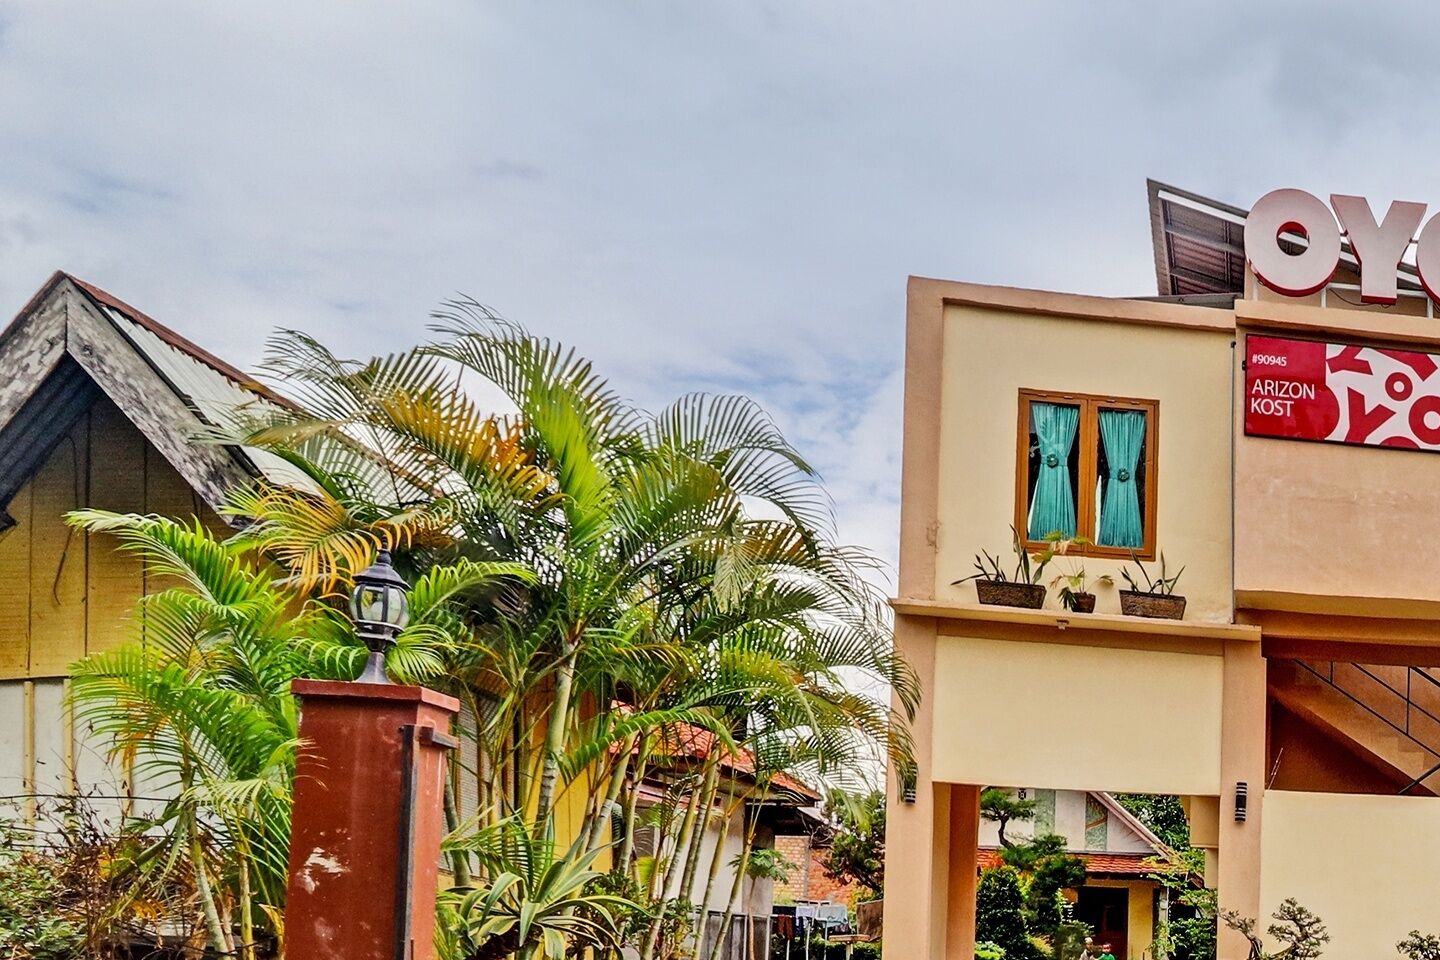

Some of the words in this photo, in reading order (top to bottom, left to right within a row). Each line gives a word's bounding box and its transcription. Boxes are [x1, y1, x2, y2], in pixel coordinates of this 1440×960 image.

[1252, 354, 1287, 367] #90945
[1251, 378, 1315, 400] ARIZON
[1250, 397, 1295, 417] KOST
